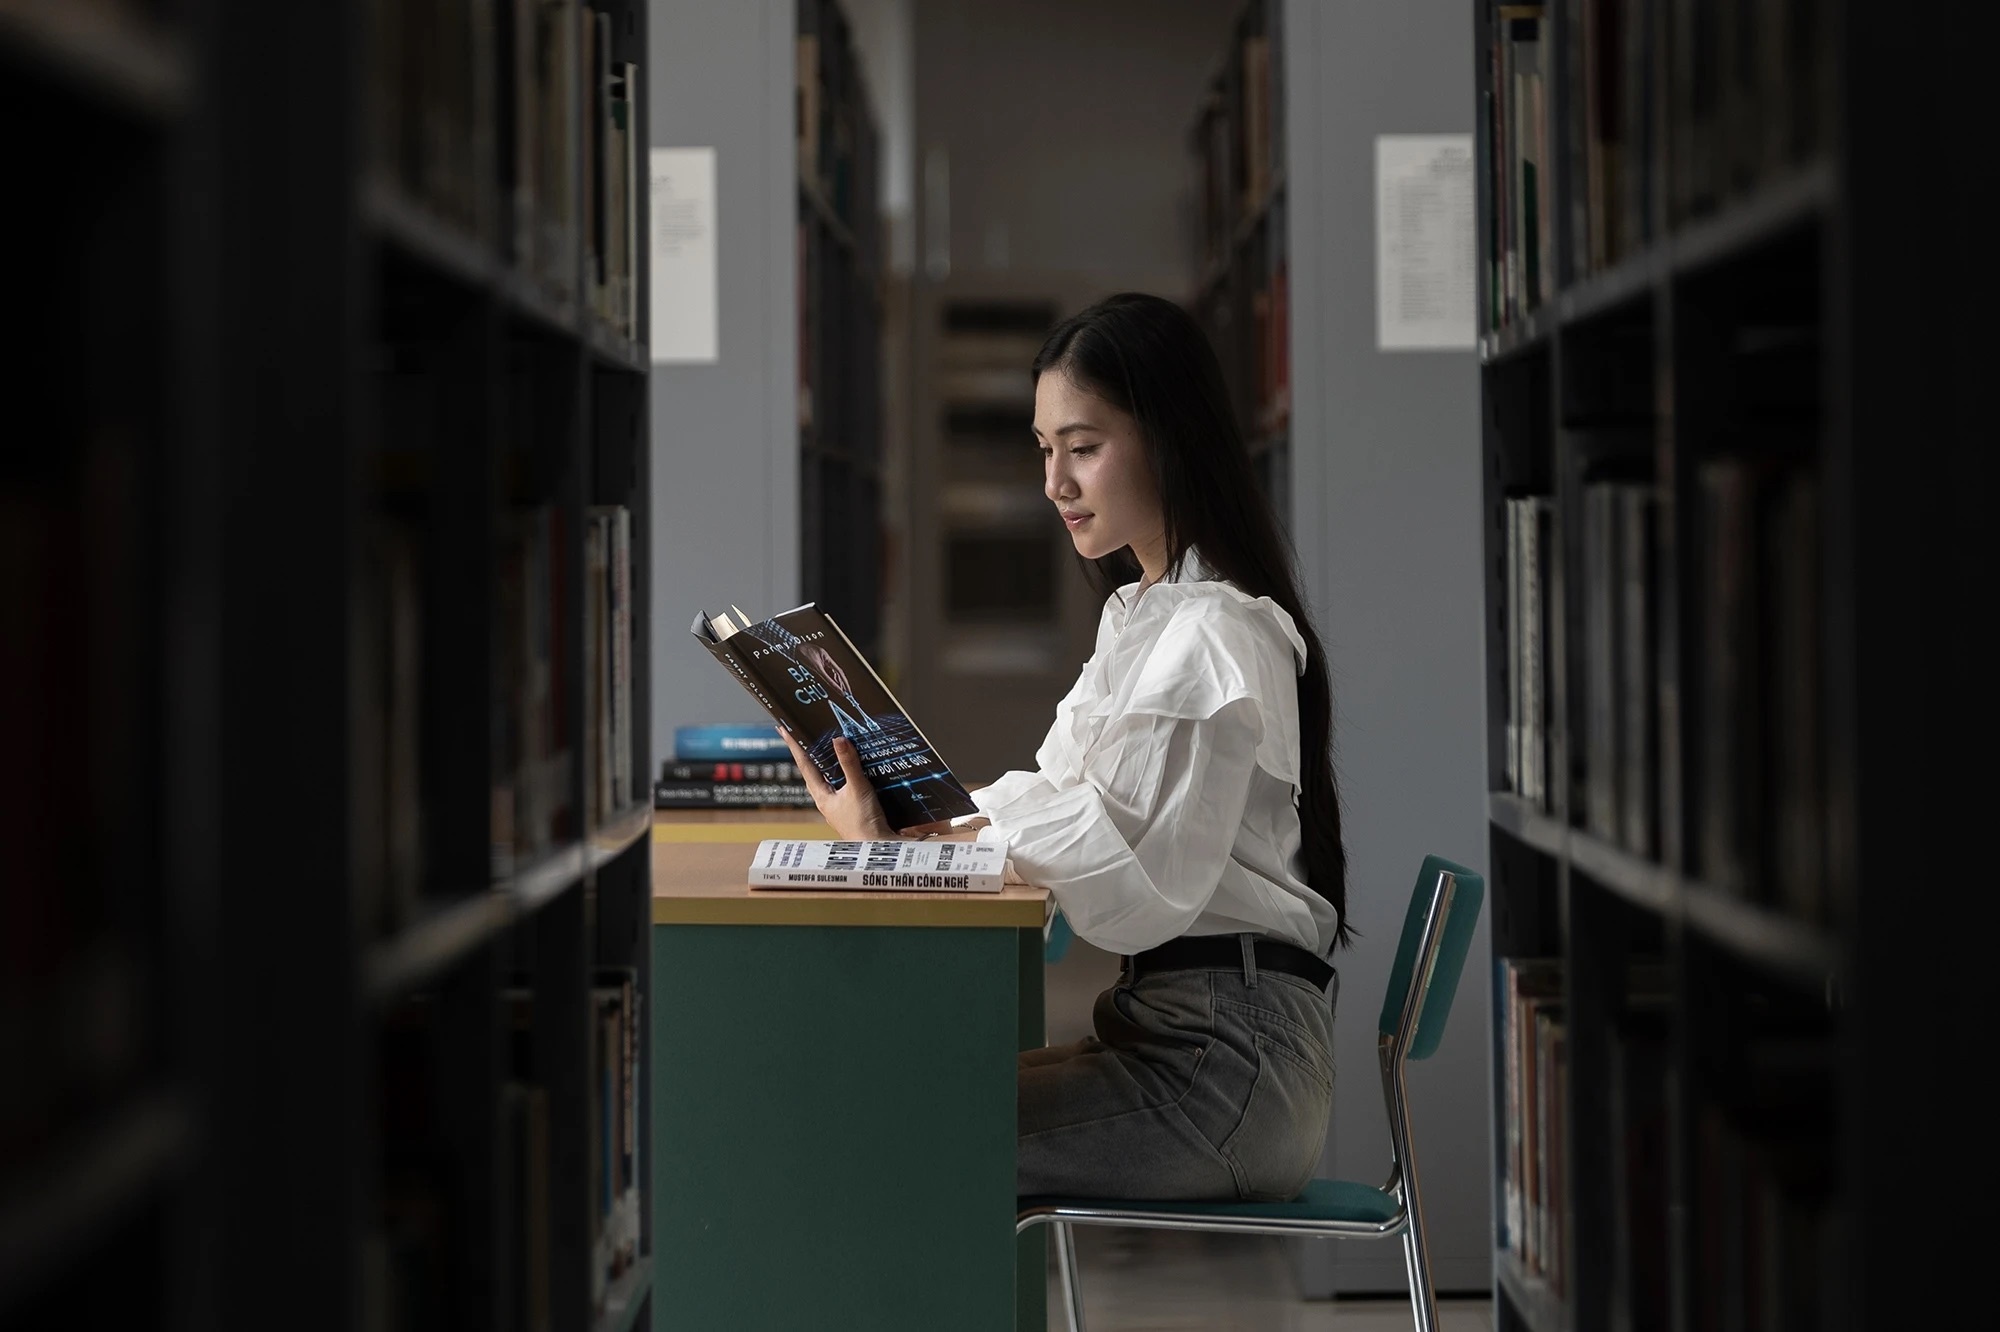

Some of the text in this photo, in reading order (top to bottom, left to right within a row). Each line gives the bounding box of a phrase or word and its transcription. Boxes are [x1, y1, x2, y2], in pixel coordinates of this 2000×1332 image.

[753, 631, 825, 659] Parmy Olson
[725, 653, 773, 709] PARMY OLSON
[794, 679, 829, 704] CHỦ
[892, 757, 912, 771] THẾ
[788, 873, 815, 882] MUSTAFA
[817, 875, 848, 883] SULEYMAN
[862, 872, 888, 886] SÓNG
[890, 873, 914, 887] THẦN
[917, 874, 942, 888] CÔNG
[944, 875, 969, 890] NGHỆ
